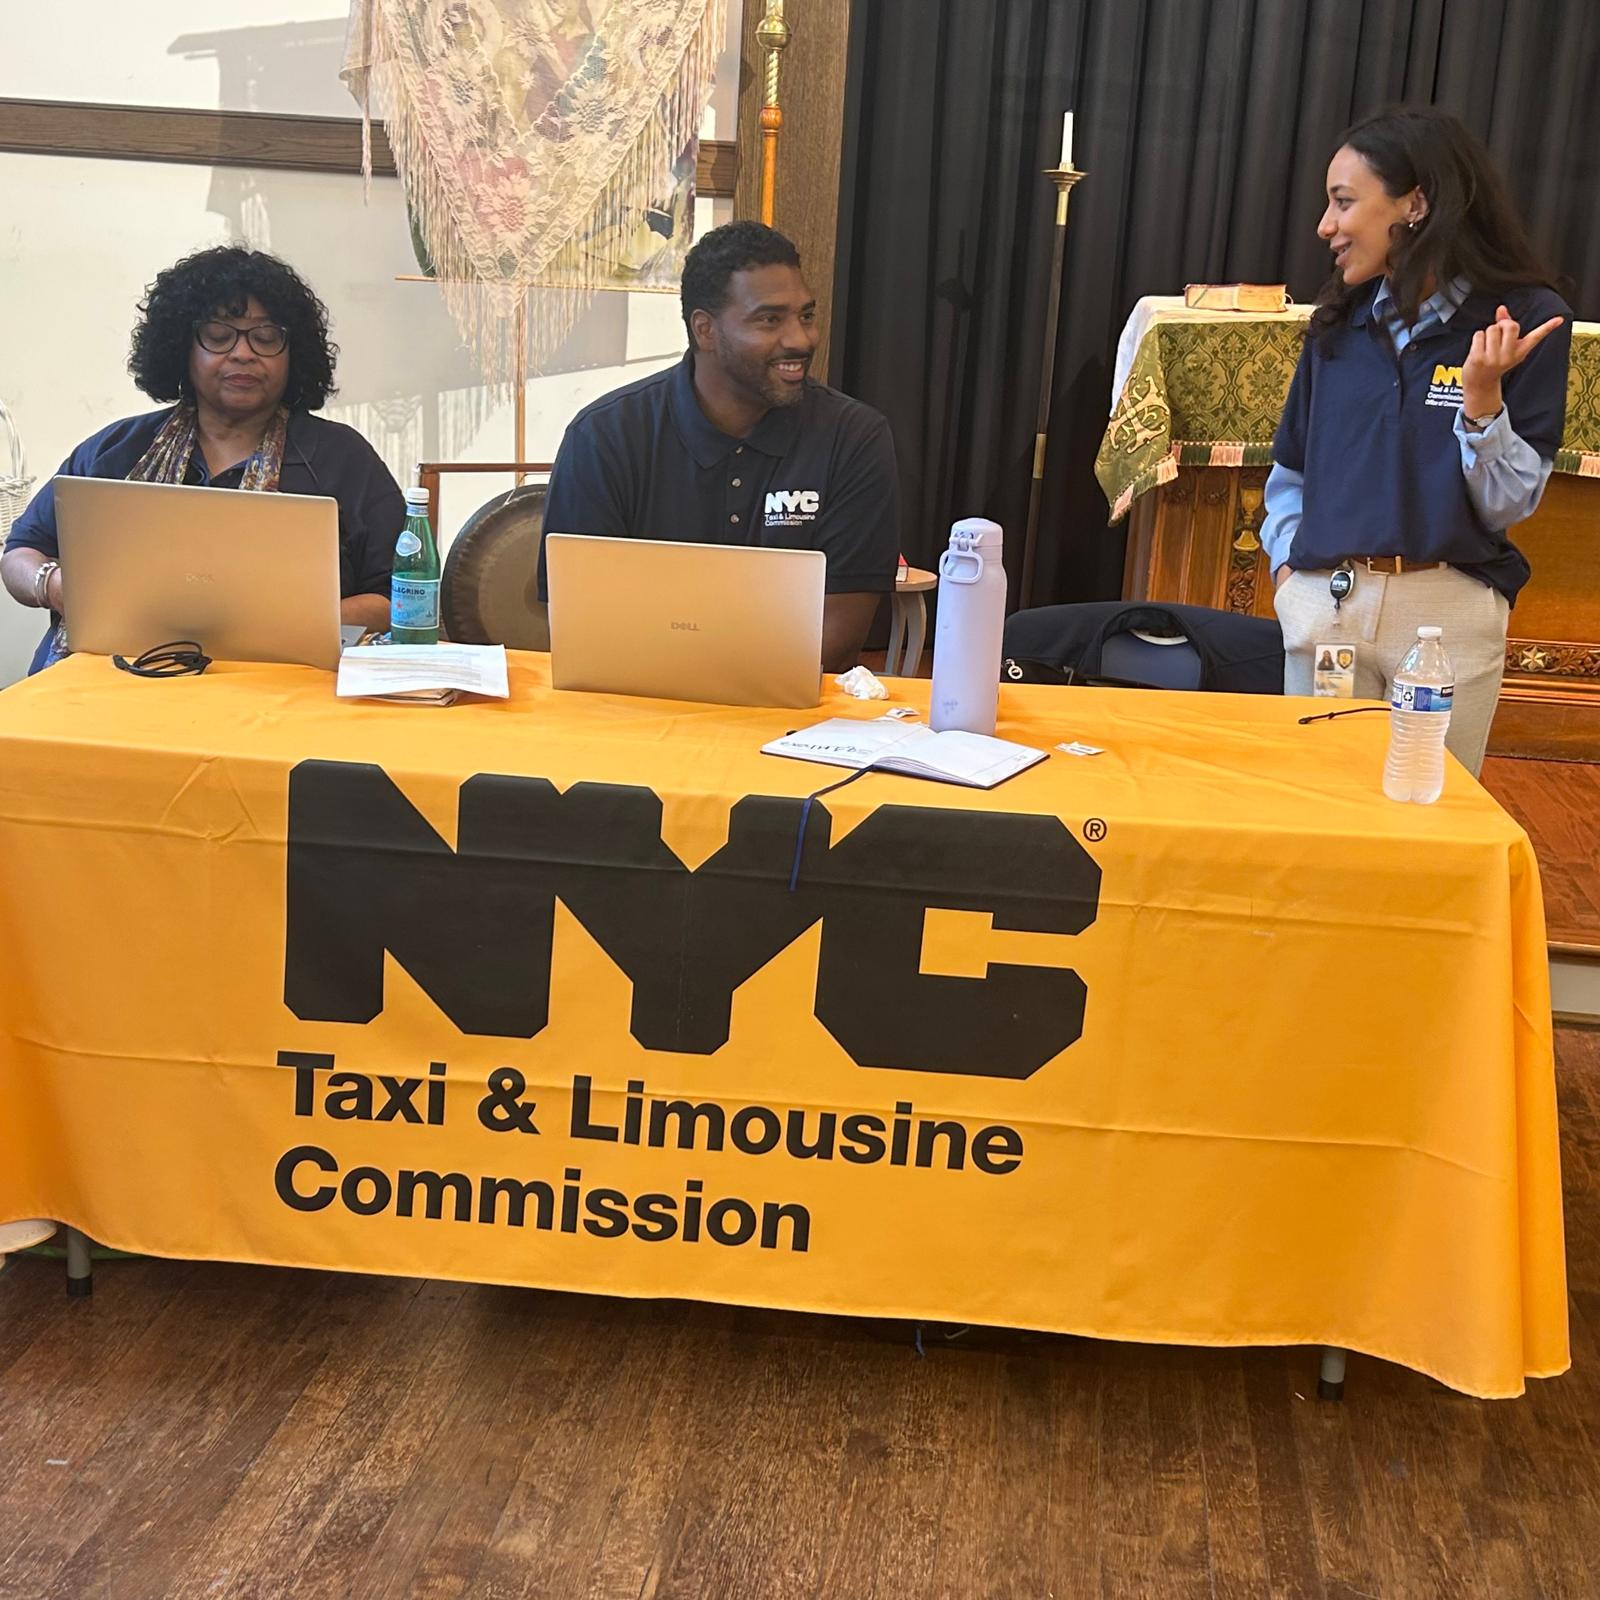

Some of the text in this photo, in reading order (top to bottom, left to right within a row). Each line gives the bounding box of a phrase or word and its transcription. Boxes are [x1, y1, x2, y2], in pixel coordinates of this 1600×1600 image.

[764, 491, 819, 513] NYC
[764, 513, 778, 522] Taxi
[671, 622, 700, 631] DELL
[284, 758, 1103, 1080] NYC
[276, 1050, 1024, 1175] Taxi & Limousine
[274, 1145, 811, 1252] Commission
